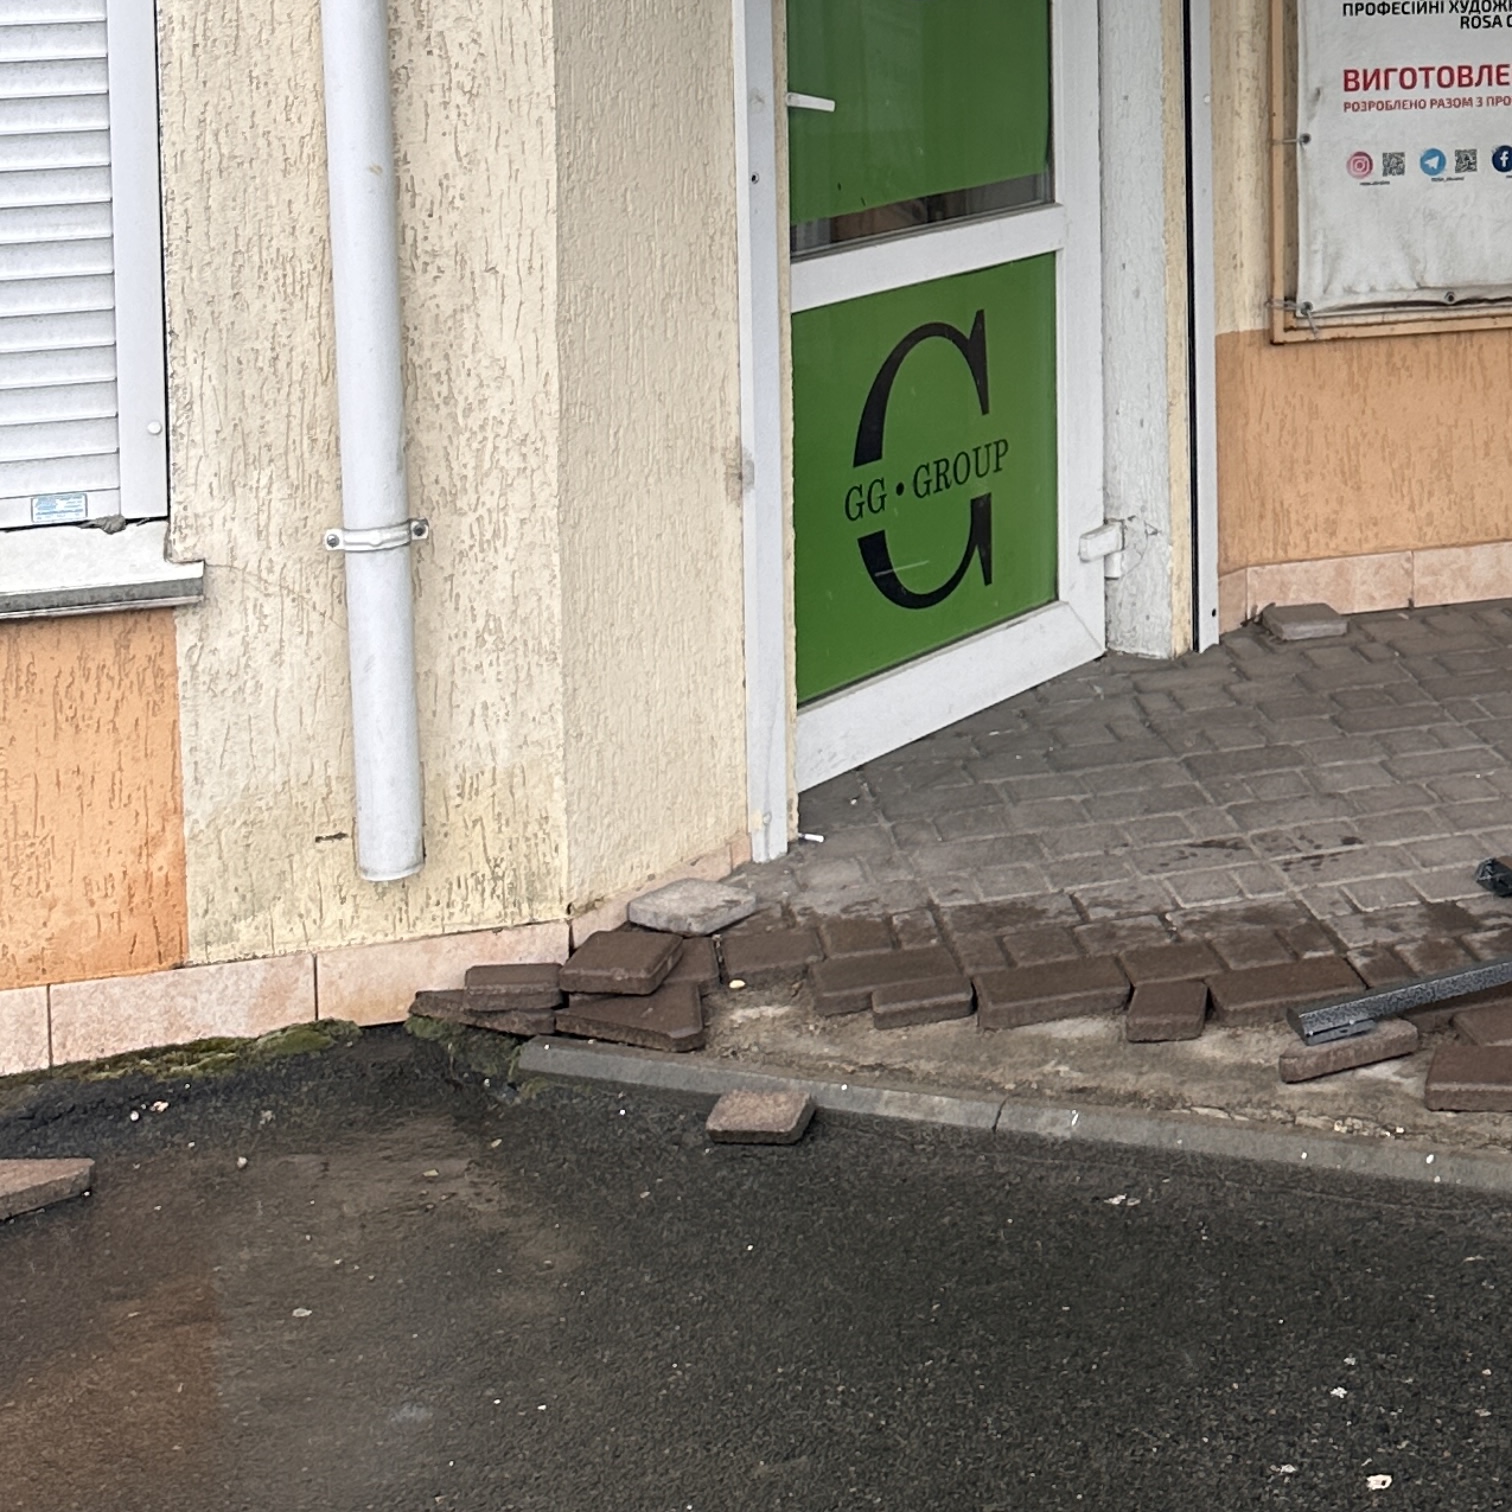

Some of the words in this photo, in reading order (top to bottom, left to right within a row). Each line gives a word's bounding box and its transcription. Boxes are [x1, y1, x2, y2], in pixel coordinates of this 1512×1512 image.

[1460, 14, 1503, 29] ROSA
[1343, 99, 1427, 113] РОЗРОБЛЕНО
[1430, 96, 1474, 109] РАЗОМ
